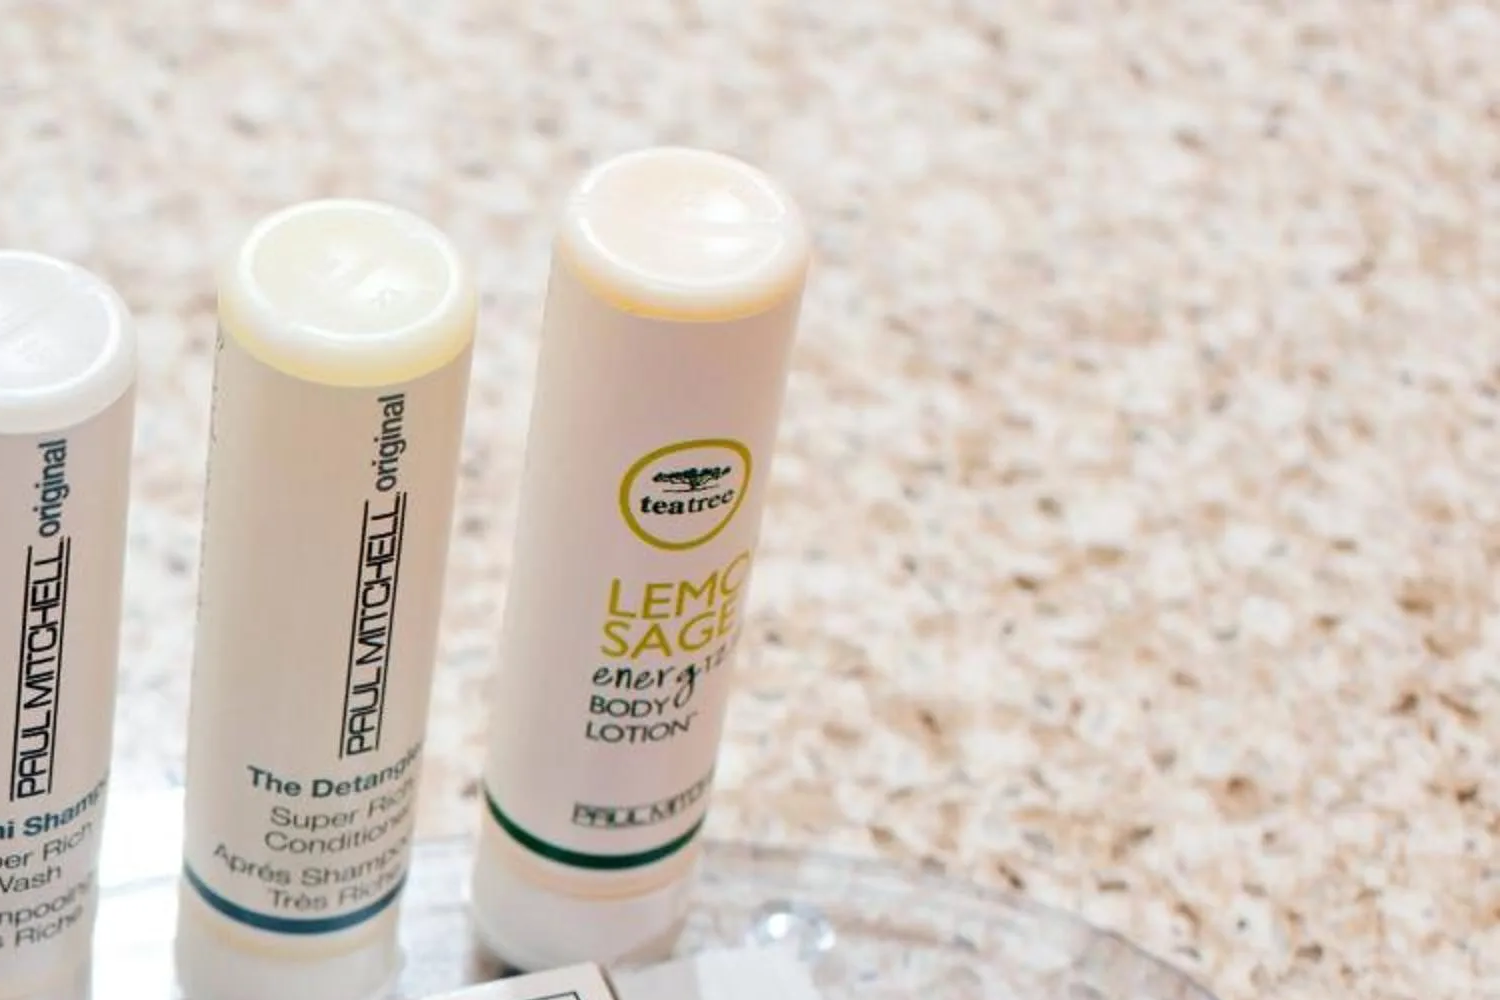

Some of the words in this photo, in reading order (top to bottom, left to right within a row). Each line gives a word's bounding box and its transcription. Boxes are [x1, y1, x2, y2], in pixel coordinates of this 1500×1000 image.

[371, 393, 407, 492] original
[33, 438, 70, 538] original
[356, 492, 401, 666] MITCHELL
[23, 536, 64, 710] MITCHELL
[600, 597, 737, 660] SAGE
[346, 666, 382, 756] PAUL
[584, 714, 692, 745] LOTION
[589, 694, 670, 718] BODY
[17, 709, 52, 799] PAUL
[246, 765, 301, 797] The
[43, 821, 93, 862] Rich
[270, 805, 359, 832] Super
